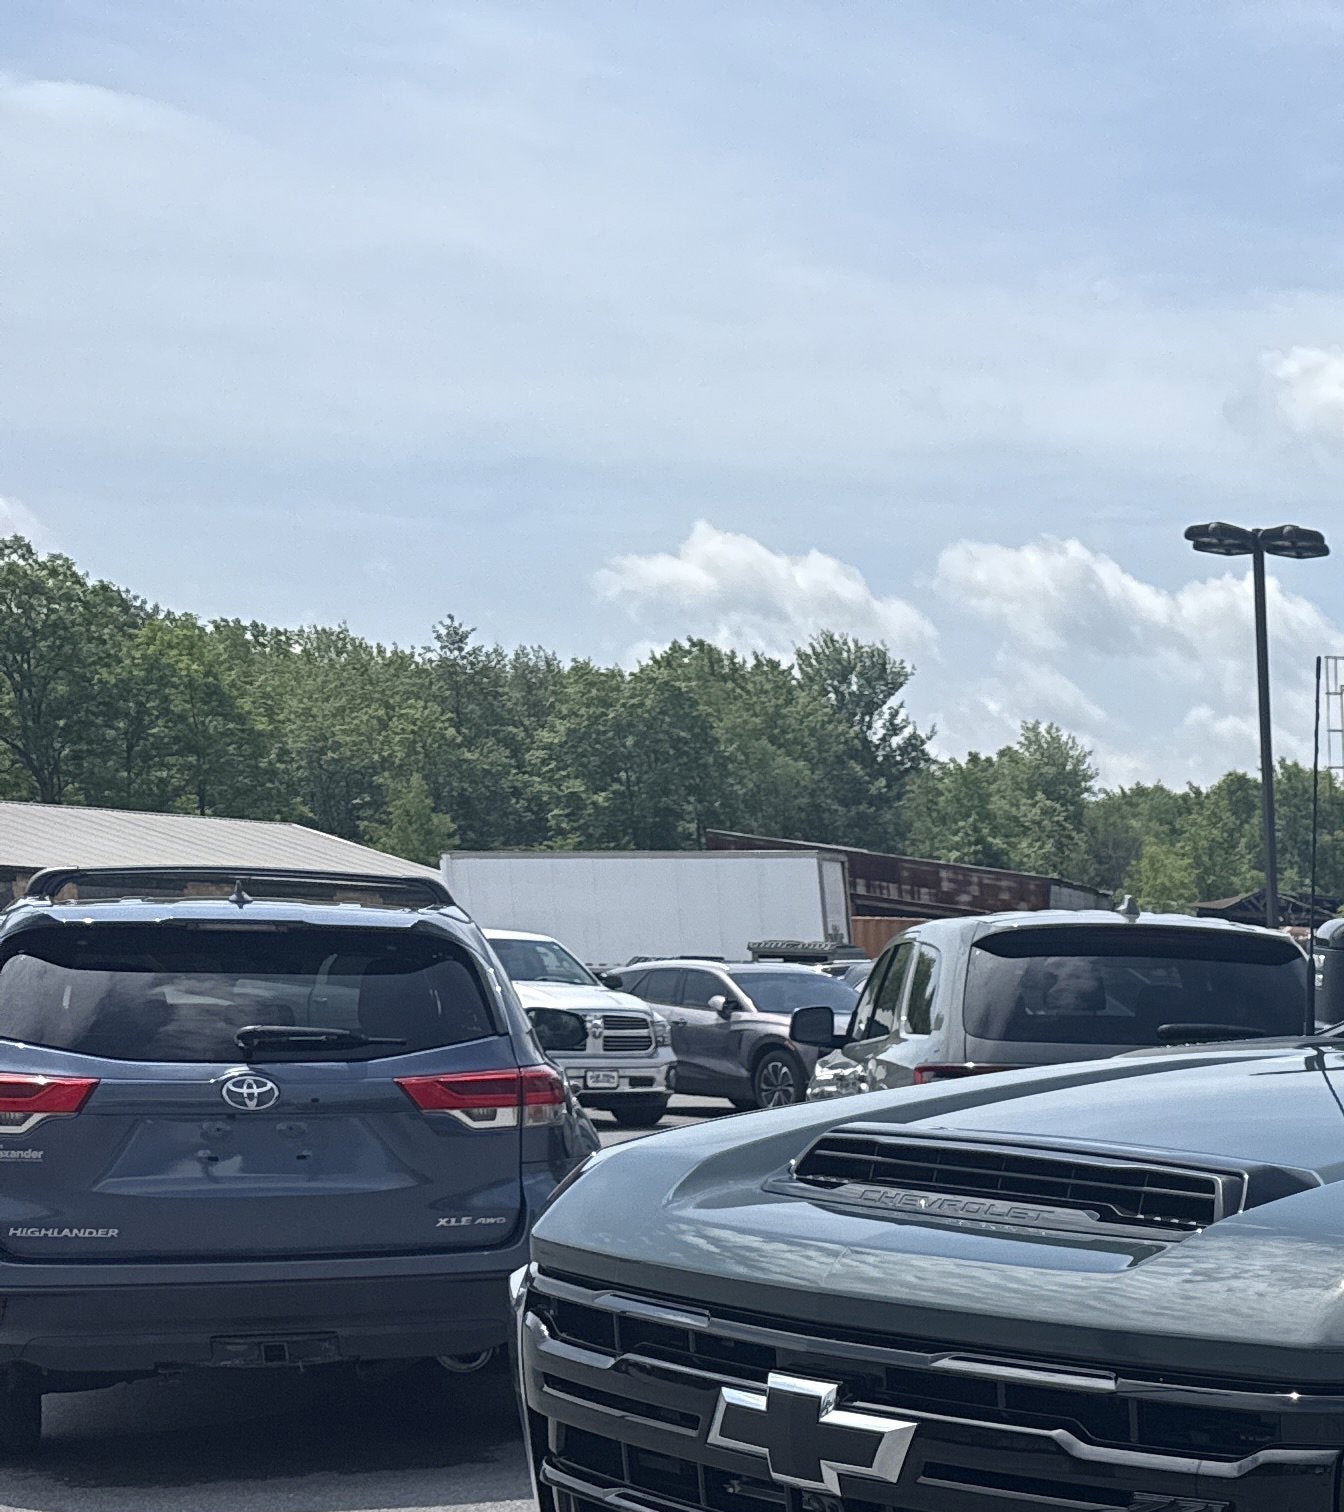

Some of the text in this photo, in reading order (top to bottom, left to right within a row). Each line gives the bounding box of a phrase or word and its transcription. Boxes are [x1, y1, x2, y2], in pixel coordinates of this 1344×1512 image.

[858, 1189, 1055, 1222] CHEVROLET
[435, 1216, 507, 1227] XLE AWD
[8, 1227, 119, 1238] HIGHLANDER
